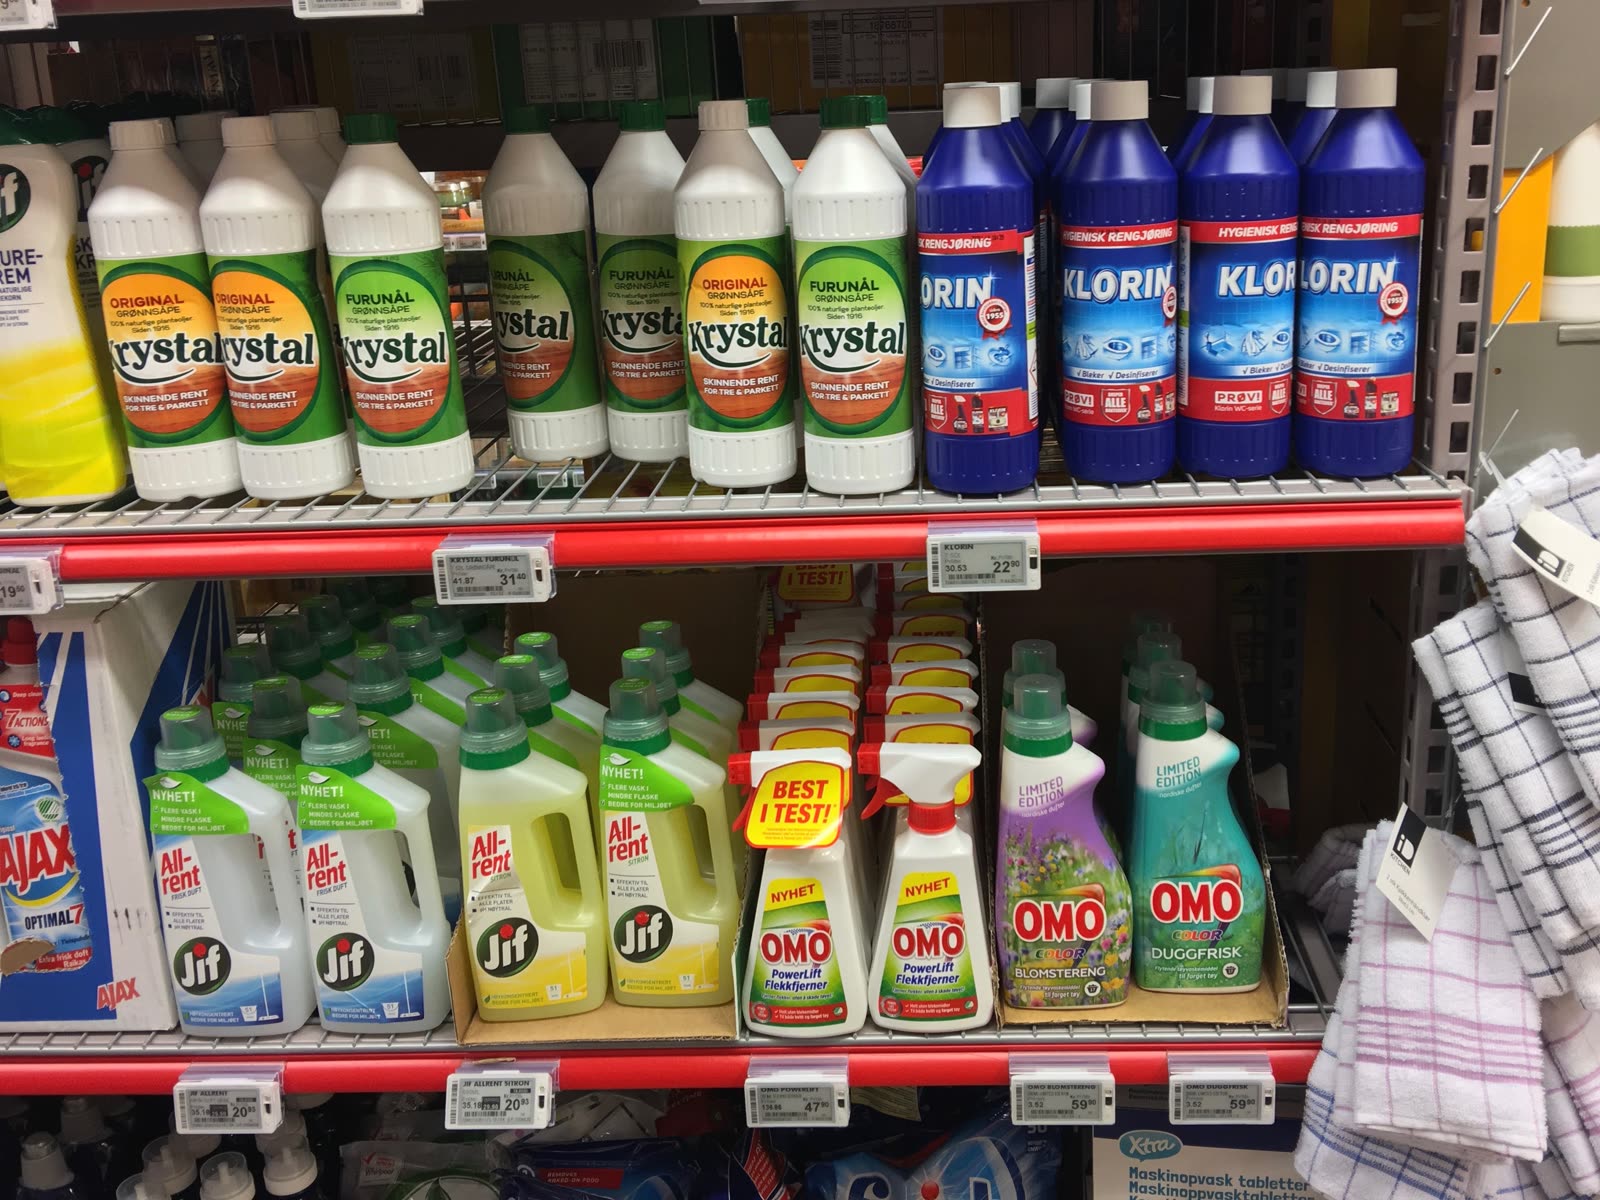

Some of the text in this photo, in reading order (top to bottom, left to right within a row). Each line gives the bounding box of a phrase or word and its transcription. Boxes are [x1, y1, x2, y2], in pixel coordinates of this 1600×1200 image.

[1108, 227, 1173, 242] RENGJØRING
[1218, 225, 1278, 238] HYGIENISK
[1322, 221, 1398, 234] RENGJØRING
[0, 250, 43, 266] URE-
[609, 267, 675, 281] FURUNÅL
[1218, 260, 1296, 296] KLOR
[1301, 260, 1396, 294] LORIN
[703, 277, 767, 290] ORIGINAL
[810, 277, 879, 292] FURUNÅL
[1064, 266, 1172, 302] KLORIN
[346, 289, 415, 305] FURUNÅL
[708, 290, 764, 299] GRØNNSÅPE
[920, 275, 992, 310] ORIN
[110, 294, 184, 308] ORIGINAL
[986, 312, 1004, 320] 1955
[689, 317, 787, 354] Krystal
[800, 322, 904, 358] Krystal
[110, 333, 224, 370] rystal
[1250, 365, 1273, 374] Bleker
[1324, 364, 1371, 373] Desinfiserer
[704, 374, 779, 386] SKINNENDE RENT
[865, 381, 890, 391] RENT
[123, 389, 208, 403] SKINNENDE RENT
[270, 391, 298, 400] RENT
[356, 389, 434, 401] SKINNENDE RENT
[744, 384, 779, 395] PARKETT
[850, 390, 890, 400] PARKETT
[371, 399, 435, 410] TRE PARKETT
[1105, 398, 1126, 408] ALLE
[1217, 393, 1260, 402] PRØV!
[140, 399, 209, 412] TRE PARKETT
[945, 564, 967, 572] 30.53
[993, 561, 1010, 573] 22
[500, 574, 515, 585] 31
[800, 571, 843, 585] TEST!
[247, 758, 289, 769] NYHET!
[1157, 756, 1201, 777] LIMITED
[602, 765, 644, 780] NYHET!
[1156, 767, 1201, 788] EDITION
[301, 784, 344, 798] NYHET!
[773, 780, 829, 799] BEST
[1019, 776, 1064, 797] LIMITED
[152, 789, 195, 802] NYHET!
[1019, 787, 1064, 808] EDITION
[760, 804, 768, 823] I
[609, 833, 648, 863] rent
[0, 824, 76, 894] AJAX
[162, 848, 192, 877] All-
[472, 849, 511, 880] rent
[628, 855, 649, 866] SITRON
[1390, 853, 1411, 876] KITCHEN
[162, 865, 200, 895] rent
[308, 861, 346, 891] rent
[316, 882, 347, 896] FRISK DUFT
[771, 884, 816, 903] NYHET
[905, 877, 950, 898] NYHET
[1152, 882, 1242, 922] OMO
[1014, 901, 1104, 941] OMO
[621, 911, 663, 955] Jif
[1172, 930, 1223, 941] COLOR
[484, 923, 528, 970] Jif
[761, 932, 831, 963] OMO
[893, 925, 964, 958] OMO
[56, 952, 72, 961] frisk
[74, 949, 89, 958] doft
[1035, 948, 1086, 960] COLOR
[1152, 946, 1242, 960] DUGGFRISK
[181, 943, 221, 988] Jif
[323, 938, 364, 984] Jif
[903, 962, 954, 973] PowerLift
[772, 968, 822, 979] PowerLift
[1015, 967, 1106, 979] BLOMSTERENG
[765, 980, 827, 992] Flekkfjerner
[896, 974, 960, 987] Flekkfjerner
[96, 977, 140, 1012] AJAX
[505, 1100, 520, 1111] 20
[804, 1102, 820, 1112] 47
[1072, 1100, 1088, 1110] 59
[1230, 1099, 1246, 1110] 59
[233, 1107, 248, 1118] 20
[1129, 1167, 1310, 1192] Maskinopvask tabletter
